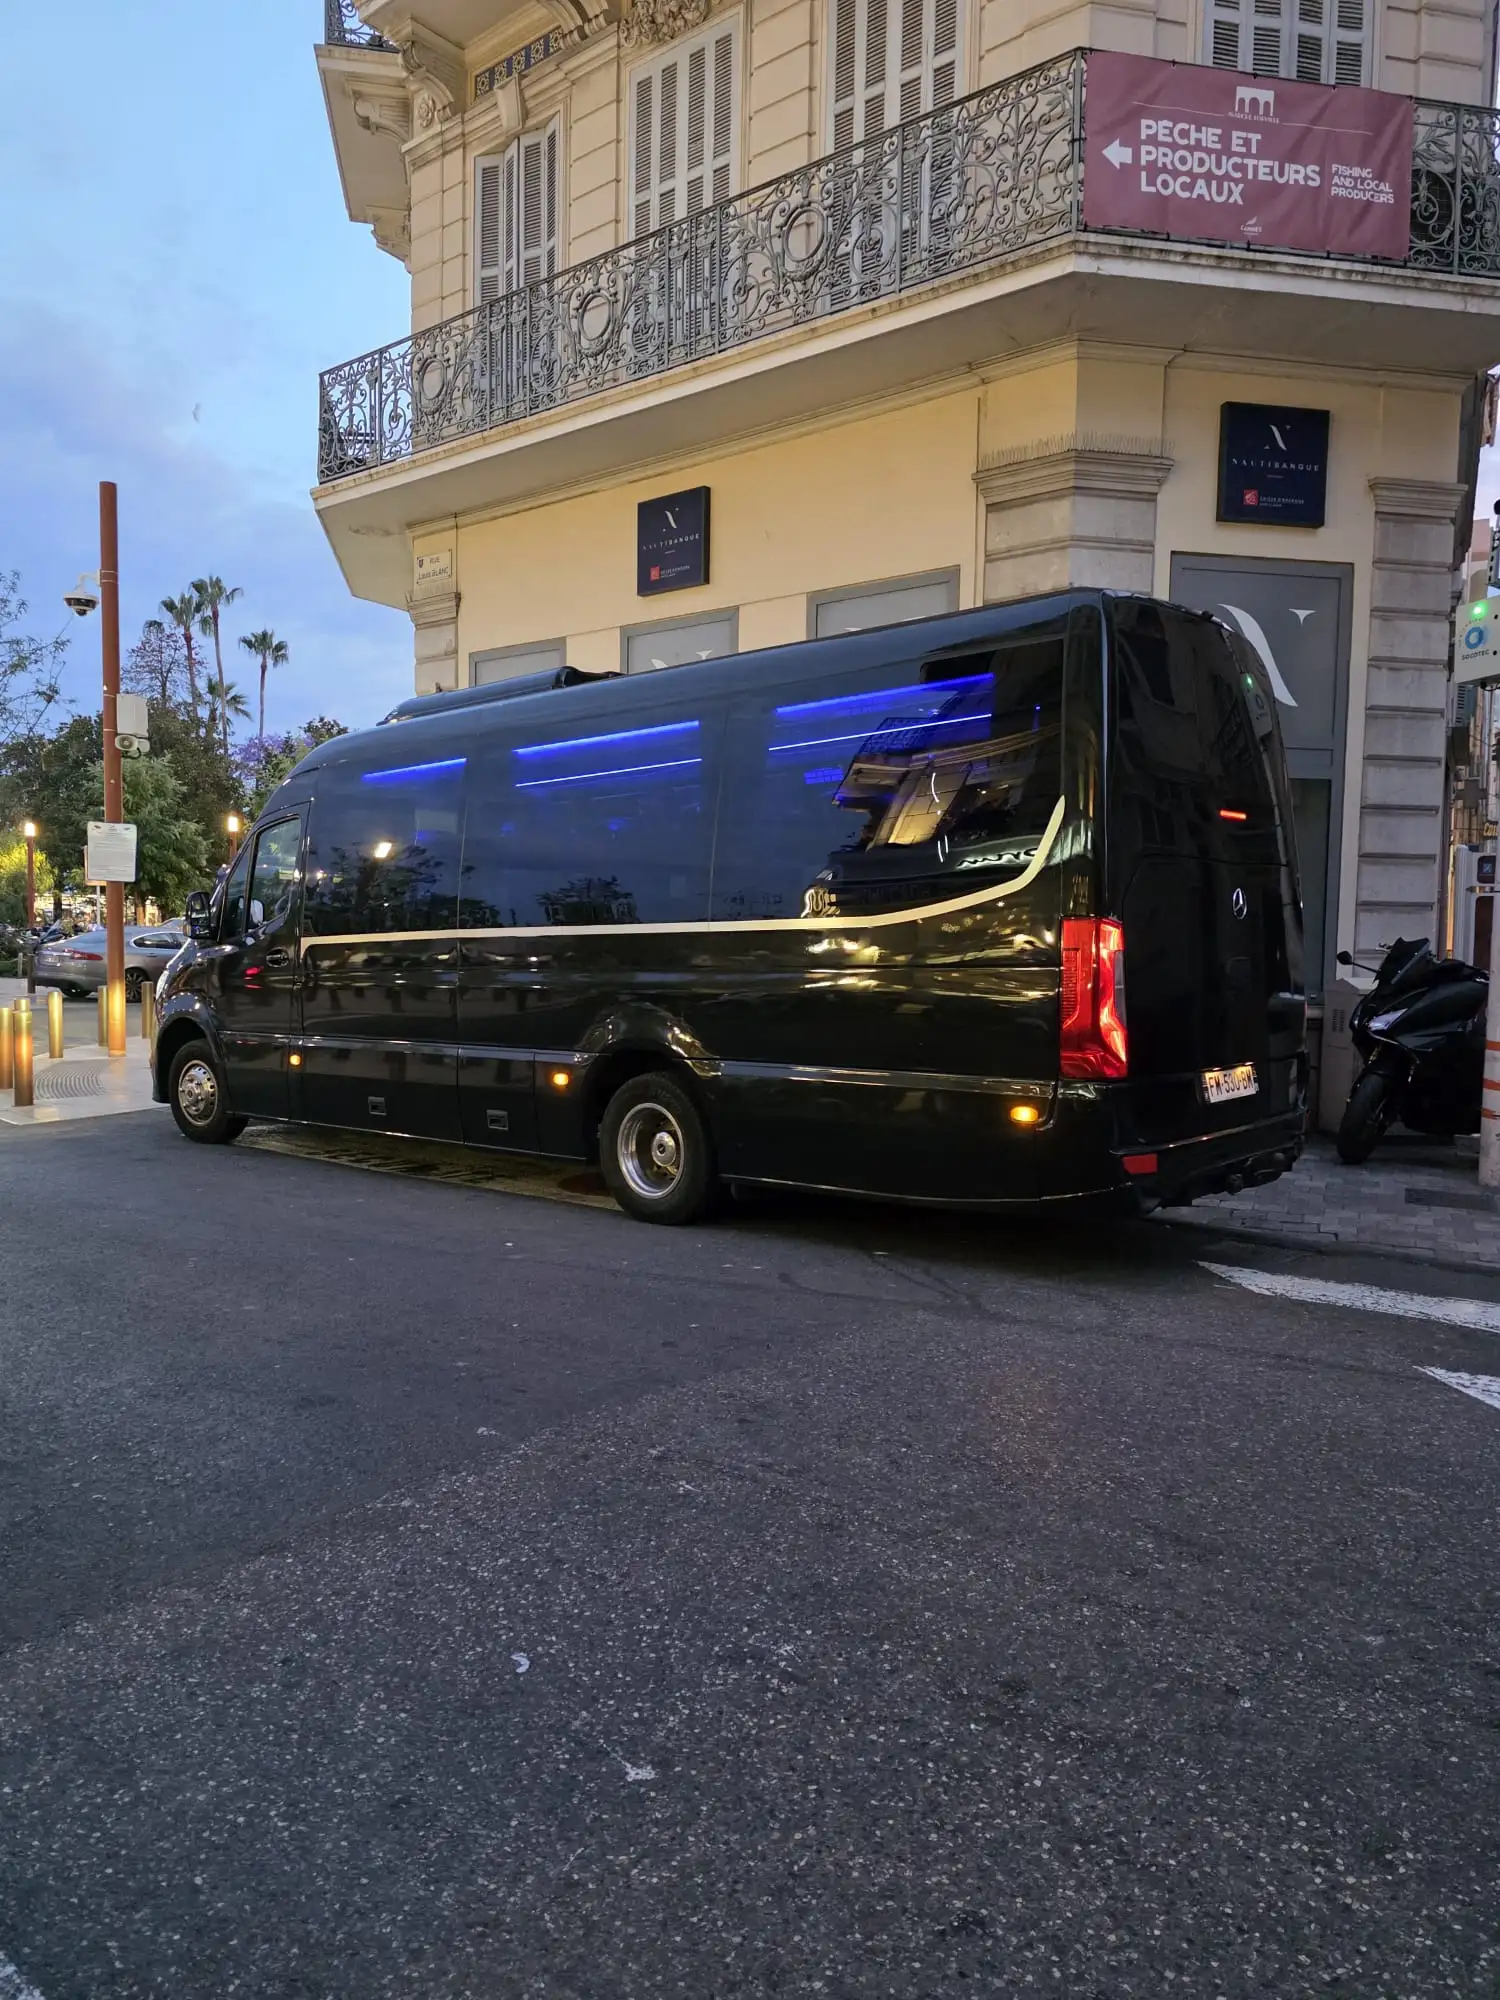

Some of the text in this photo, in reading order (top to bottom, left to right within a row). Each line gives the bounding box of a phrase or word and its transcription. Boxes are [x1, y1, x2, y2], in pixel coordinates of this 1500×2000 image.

[1231, 130, 1262, 154] ET
[1140, 144, 1321, 187] PRODUCTEURS
[1331, 163, 1373, 178] FISHING
[1140, 170, 1245, 205] LOCAUX
[1331, 175, 1393, 193] AND LOCAL
[1330, 186, 1395, 204] PRODUCERS
